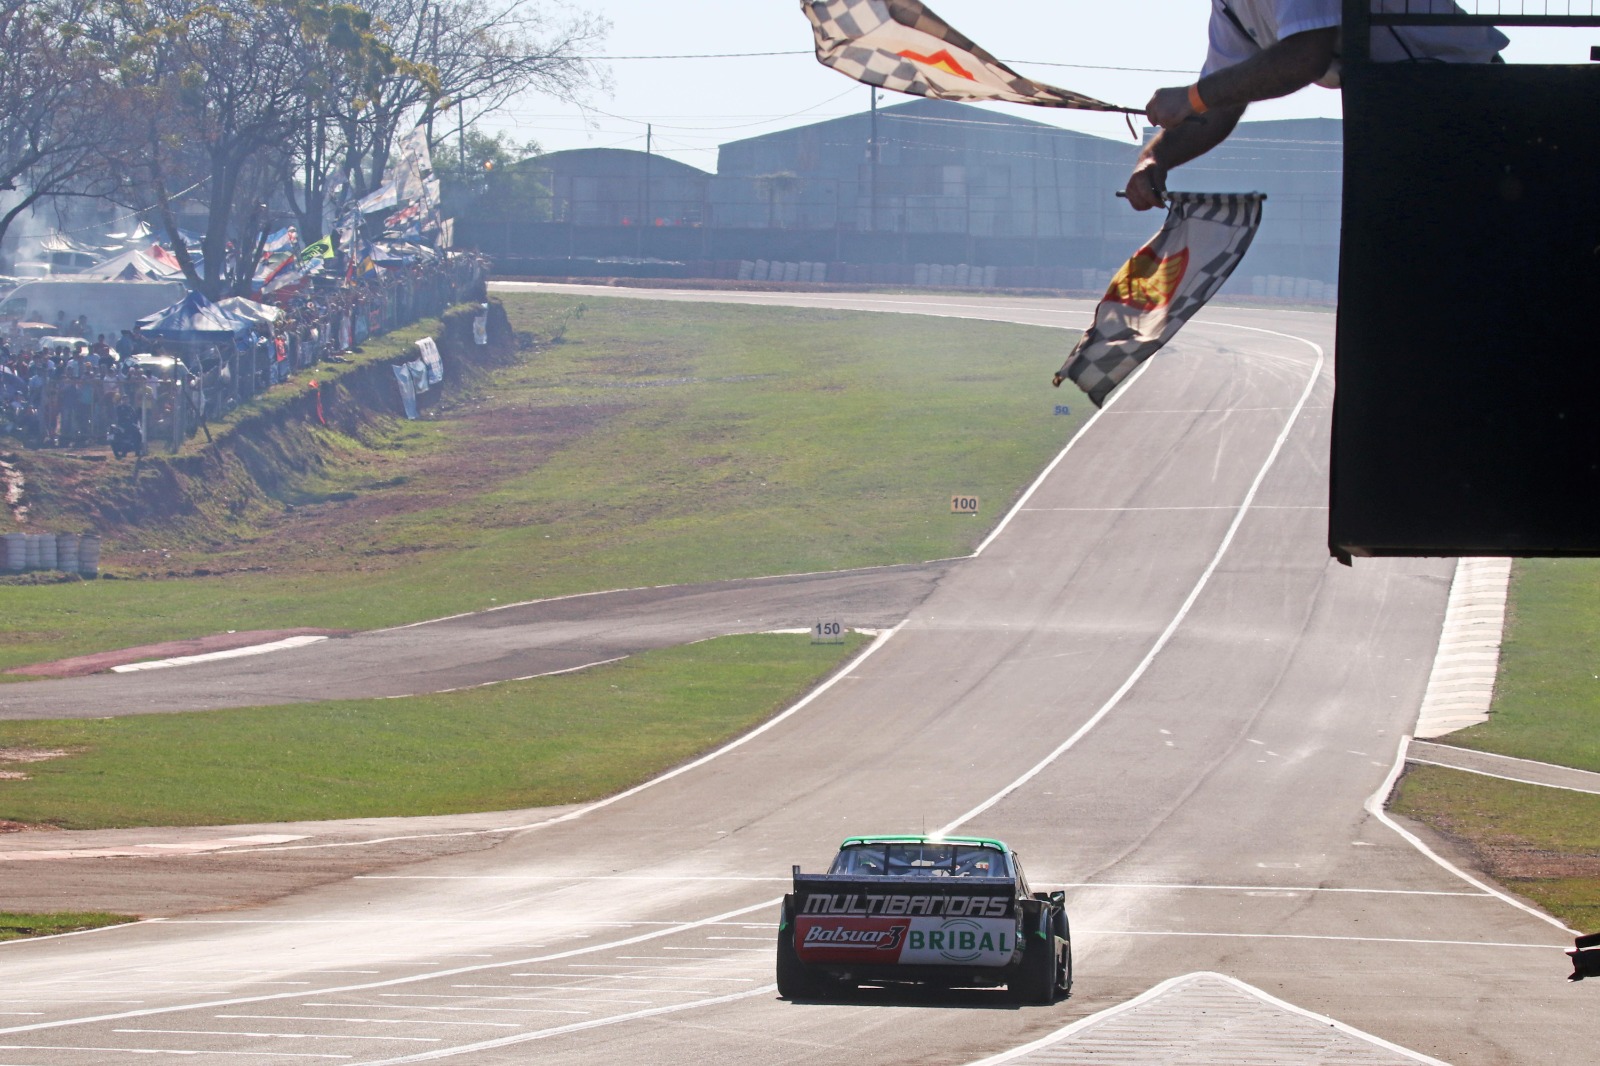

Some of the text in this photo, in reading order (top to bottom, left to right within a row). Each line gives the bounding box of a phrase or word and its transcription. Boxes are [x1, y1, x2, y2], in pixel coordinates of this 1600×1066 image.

[1055, 405, 1069, 414] 50
[952, 497, 977, 510] 100
[815, 622, 840, 635] 150
[803, 894, 1009, 916] MULTIBANDAS
[909, 930, 1011, 951] BRIBAL
